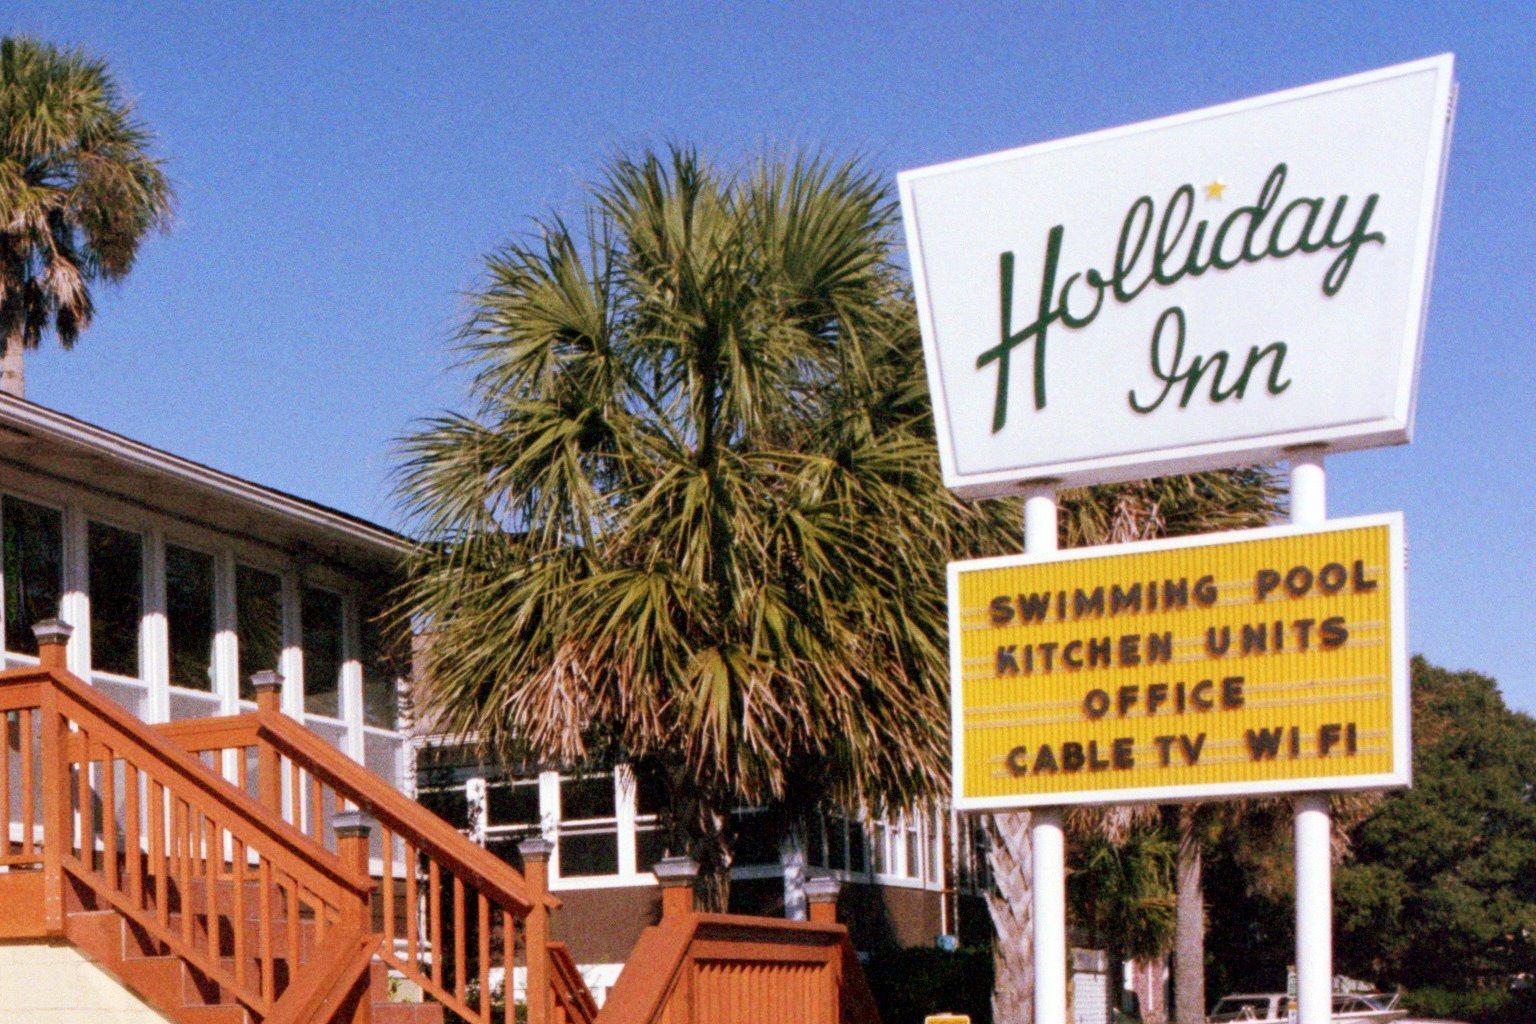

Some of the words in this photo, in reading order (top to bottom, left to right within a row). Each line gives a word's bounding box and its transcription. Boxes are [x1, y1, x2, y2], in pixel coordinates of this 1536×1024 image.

[976, 162, 1386, 434] Holliday
[1128, 306, 1291, 415] Inn
[990, 575, 1218, 626] SWIMMING
[1256, 560, 1378, 601] POOL
[996, 632, 1173, 675] KITCHEN
[1205, 616, 1349, 656] UNITS
[1083, 676, 1245, 719] OFFICE
[1006, 738, 1135, 777] CABLE
[1154, 733, 1206, 767] TV
